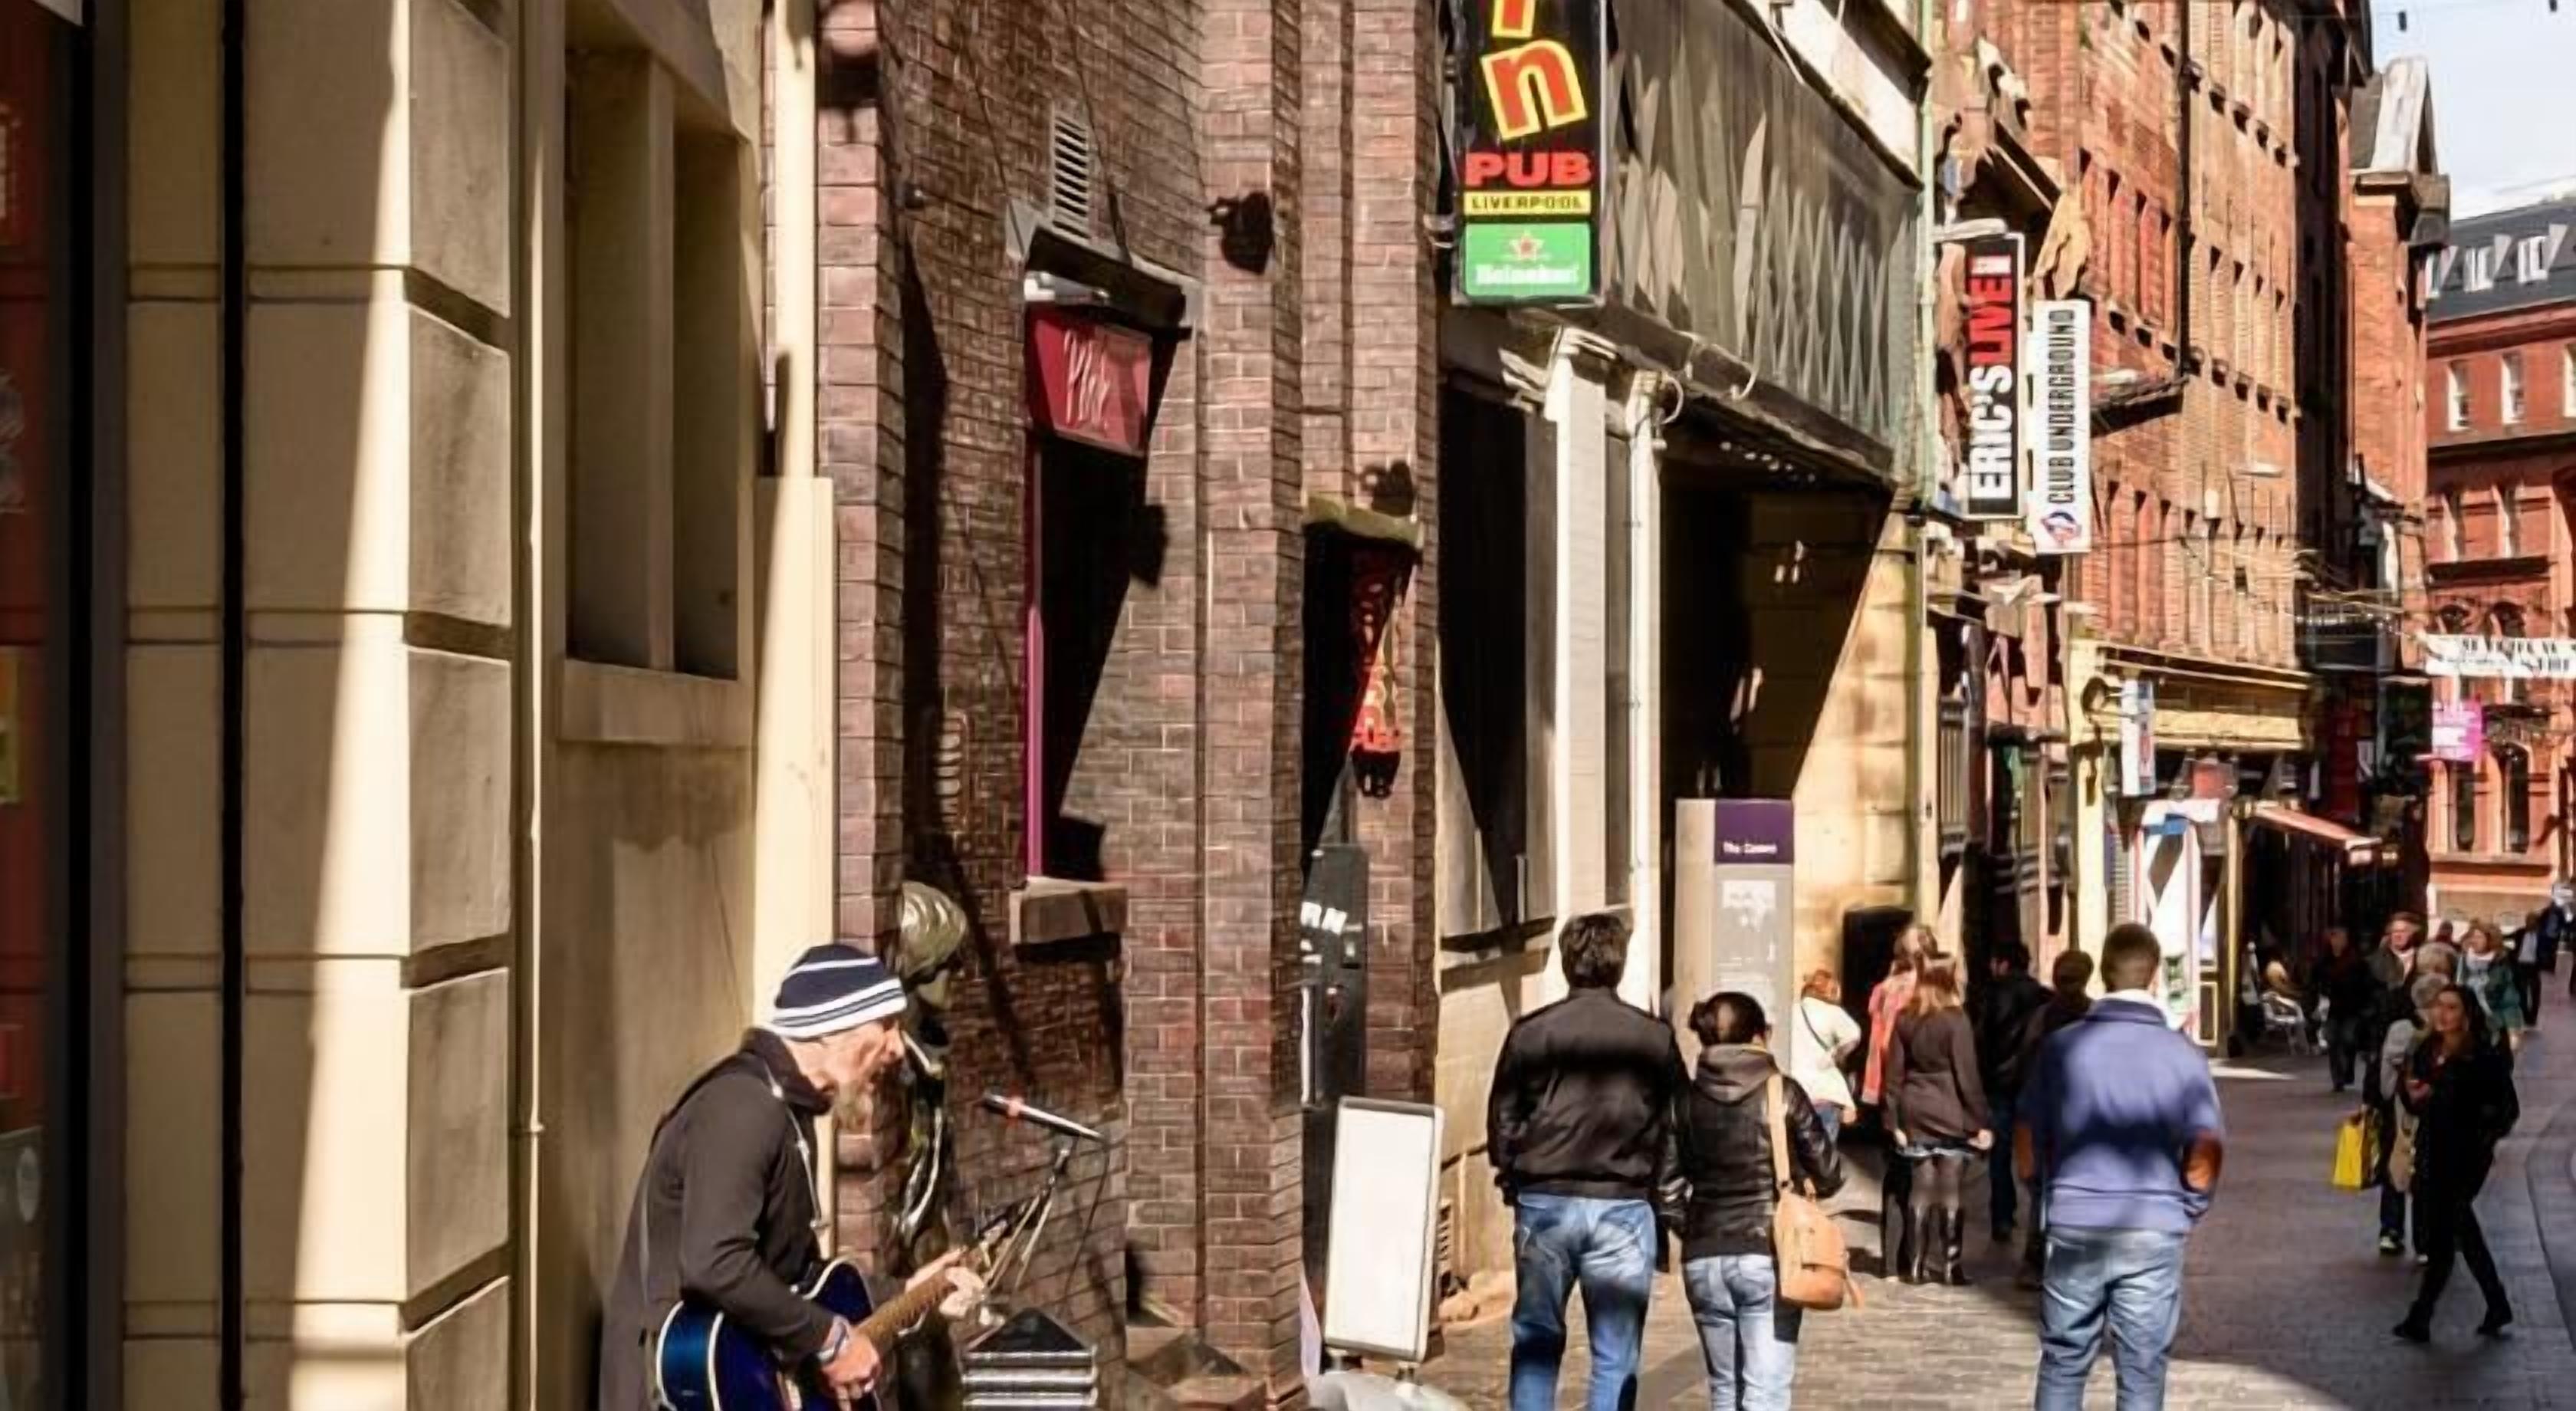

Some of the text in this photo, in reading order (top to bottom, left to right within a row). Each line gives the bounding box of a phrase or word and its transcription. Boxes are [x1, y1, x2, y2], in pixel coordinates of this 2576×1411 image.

[1465, 151, 1592, 188] PUB
[1471, 196, 1582, 209] LIVERPOOL
[1969, 364, 2013, 500] ERIC'S
[2048, 309, 2075, 504] CLUB UNDERGROUND
